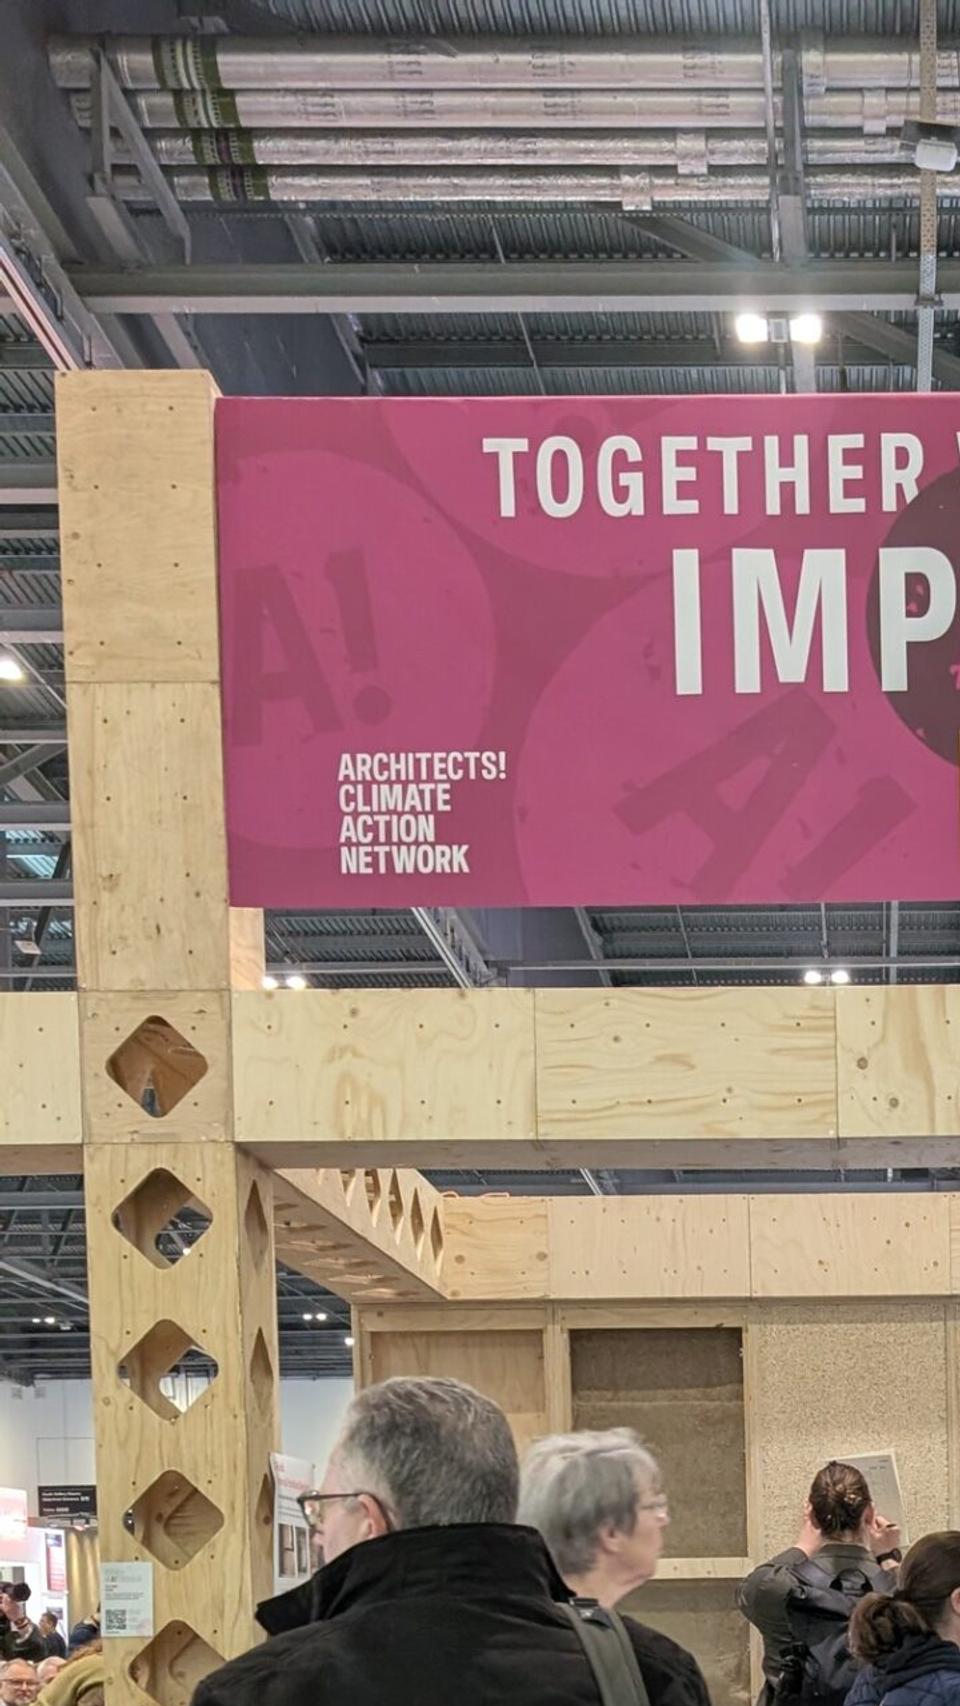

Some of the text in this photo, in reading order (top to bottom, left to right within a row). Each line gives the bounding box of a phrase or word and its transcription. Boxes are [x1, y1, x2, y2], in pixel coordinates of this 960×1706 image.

[482, 432, 925, 518] TOGETHER
[338, 751, 507, 782] ARCHITECTS!
[339, 783, 451, 813] CLIMATE
[339, 814, 435, 843] ACTION
[340, 844, 470, 874] NETWORK
